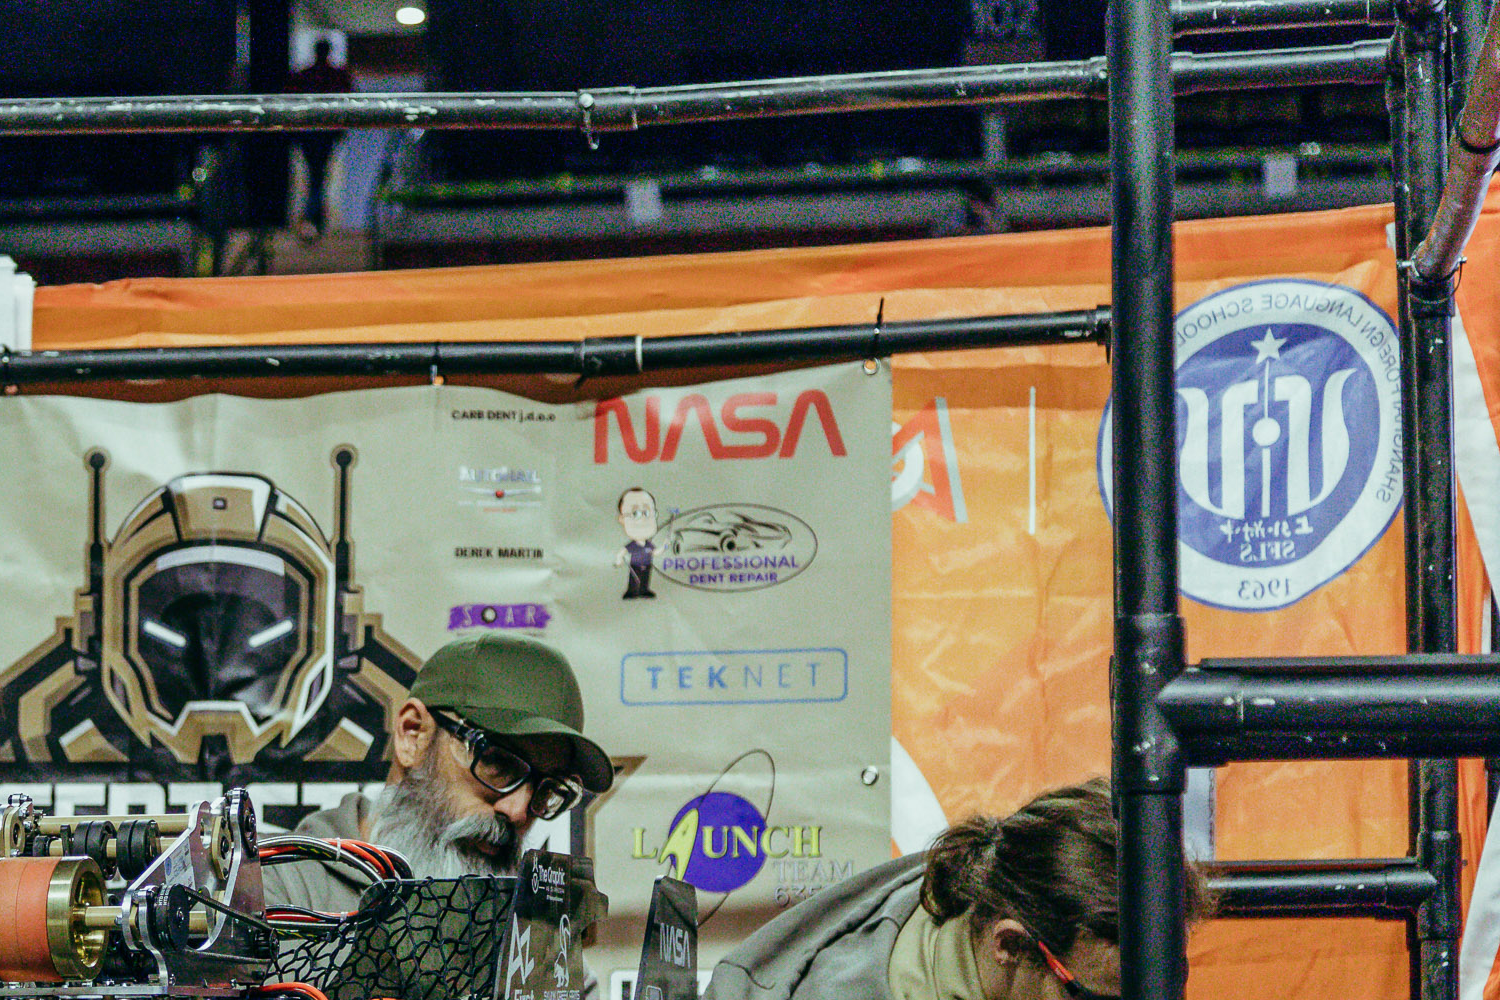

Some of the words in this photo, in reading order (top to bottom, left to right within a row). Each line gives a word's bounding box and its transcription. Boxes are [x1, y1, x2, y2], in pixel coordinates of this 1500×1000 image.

[594, 389, 848, 464] NASA
[454, 547, 493, 559] DEREK
[662, 554, 800, 572] PROFESSIONAL
[689, 574, 725, 584] DENT
[729, 572, 779, 583] REPAIR
[645, 661, 822, 691] TEKNET
[772, 859, 854, 884] TEAM
[660, 922, 691, 969] NASA
